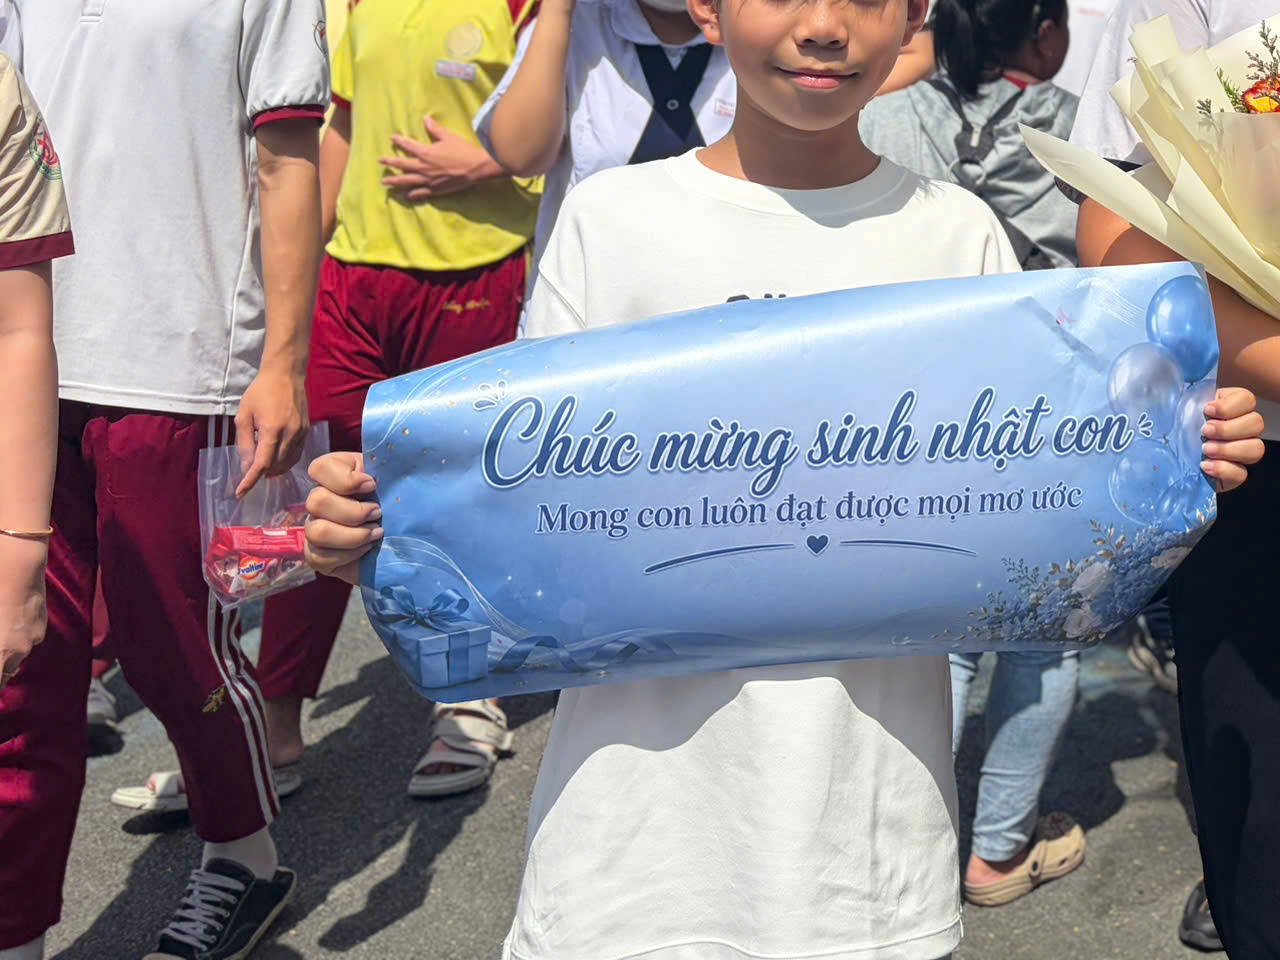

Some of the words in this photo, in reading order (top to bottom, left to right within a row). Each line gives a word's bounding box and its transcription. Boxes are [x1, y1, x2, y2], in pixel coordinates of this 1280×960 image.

[483, 394, 641, 488] Chúc
[649, 419, 798, 497] mừng
[806, 390, 919, 466] sinh
[925, 386, 1051, 471] nhật
[1053, 413, 1134, 456] con
[536, 504, 629, 539] Mong
[637, 505, 692, 528] con
[701, 496, 767, 526] luôn
[776, 494, 827, 527] đạt
[835, 490, 909, 524] được
[918, 487, 970, 520] mọi
[979, 491, 1028, 512] mơ
[1031, 481, 1083, 510] ước
